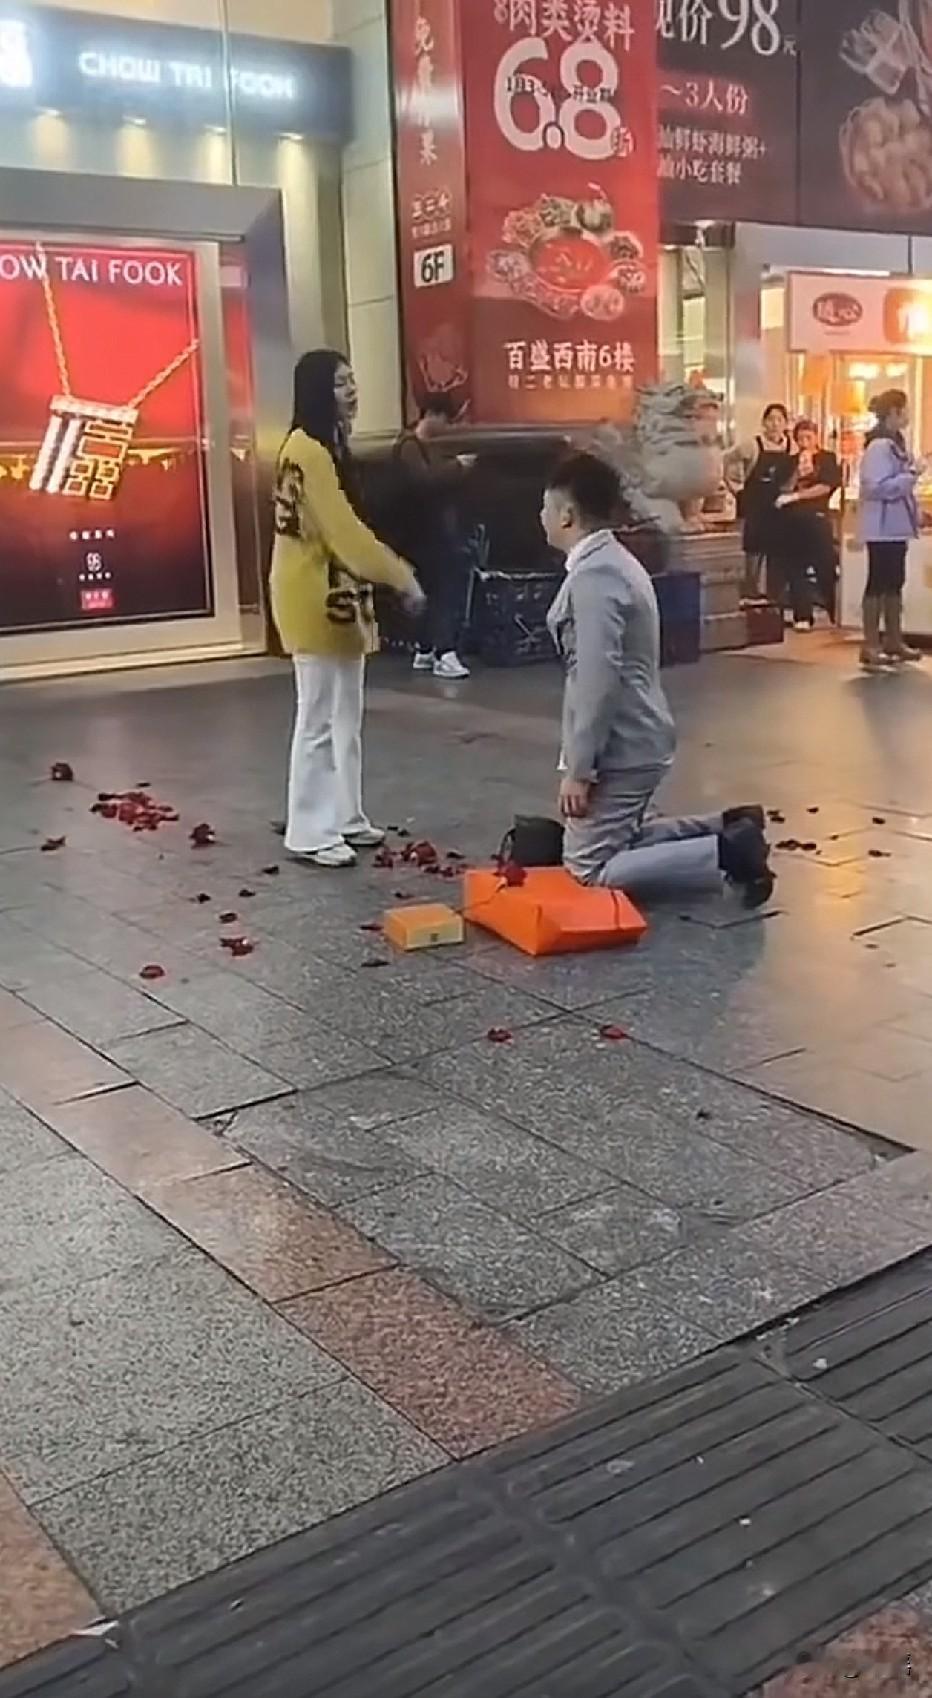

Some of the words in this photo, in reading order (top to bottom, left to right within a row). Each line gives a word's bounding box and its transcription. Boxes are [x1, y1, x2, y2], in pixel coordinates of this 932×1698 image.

[78, 51, 160, 84] CHOW
[169, 61, 211, 88] TAI
[55, 257, 97, 281] TAI
[108, 260, 183, 286] FOOK
[421, 250, 445, 284] 6F
